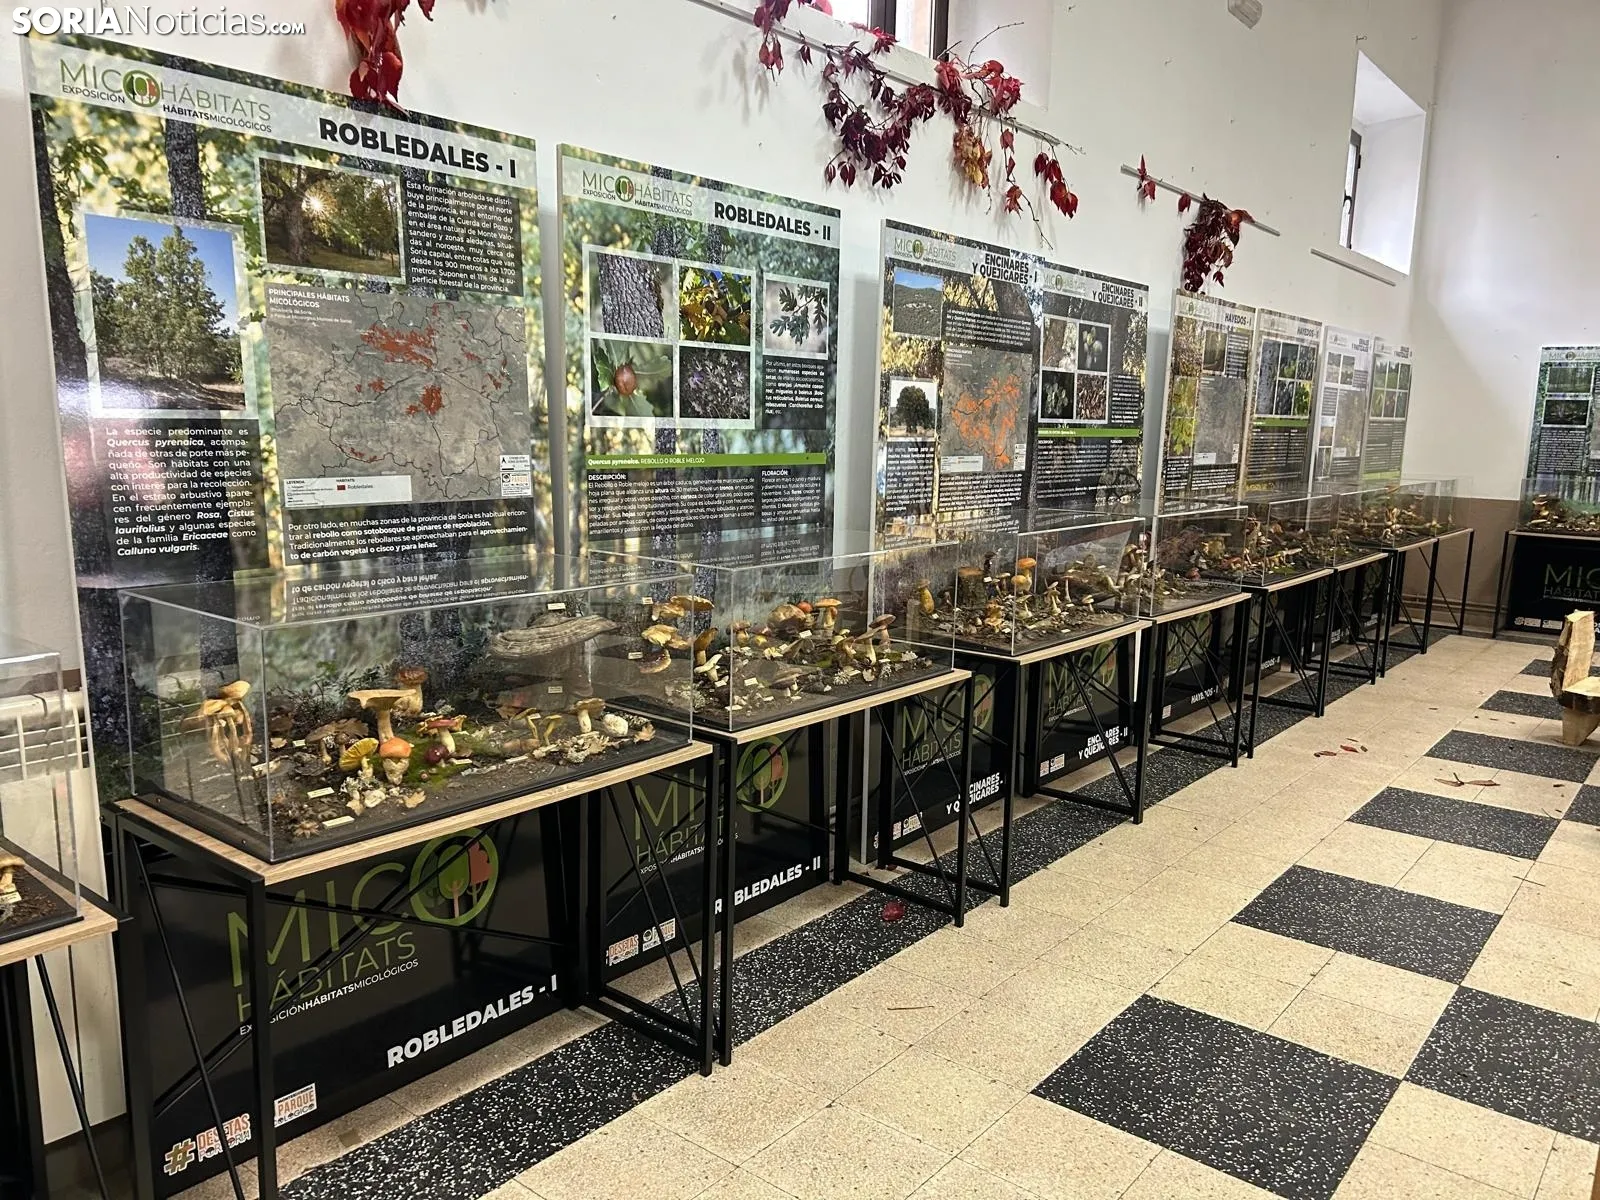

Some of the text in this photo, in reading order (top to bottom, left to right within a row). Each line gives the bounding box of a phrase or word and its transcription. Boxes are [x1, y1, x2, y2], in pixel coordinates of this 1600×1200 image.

[62, 84, 125, 105] EXPOSICIÓN
[319, 117, 490, 173] ROBLEDALES
[714, 201, 811, 236] ROBLEDALES
[985, 252, 1029, 273] ENCINARES
[972, 262, 978, 274] Y
[980, 264, 1028, 285] QUEJIGARES
[269, 288, 315, 299] PRINCIPALES
[1102, 282, 1134, 299] ENCINARES
[1092, 290, 1097, 300] Y
[1098, 291, 1134, 309] QUEJIGARES
[1225, 312, 1246, 326] HAYEDOS
[106, 427, 118, 435] La
[125, 427, 162, 437] especie
[168, 427, 233, 437] predominante
[588, 459, 611, 467] Quercus
[110, 469, 252, 481] alta productividad de especies
[168, 483, 188, 491] para
[113, 494, 125, 502] En
[143, 492, 176, 501] estrato
[180, 490, 222, 499] arbustivo
[225, 491, 253, 499] apare-
[136, 501, 212, 511] frecuentemente
[215, 500, 254, 510] ejempla-
[136, 514, 151, 522] del
[158, 513, 191, 523] género
[227, 509, 255, 518] Cistus
[115, 524, 166, 534] laurifolius
[179, 523, 215, 532] algunas
[218, 520, 256, 530] especies
[116, 537, 129, 545] de
[133, 536, 142, 544] la
[147, 534, 178, 543] familia
[182, 532, 228, 541] Ericaceae
[290, 538, 354, 550] Tradicionalmente
[356, 537, 366, 545] los
[368, 535, 401, 544] rebollares
[411, 531, 456, 543] aprovechaban
[458, 531, 471, 539] para
[473, 528, 478, 536] el
[480, 526, 527, 538] aprovechamien-
[117, 543, 200, 556] Calluna vulgaris.
[291, 551, 299, 559] to
[300, 551, 311, 559] de
[312, 548, 339, 558] carbón
[341, 545, 368, 557] vegetal
[377, 544, 394, 552] cisco
[396, 545, 400, 553] y
[402, 543, 417, 552] para
[418, 540, 438, 549] leñas.
[1078, 749, 1083, 760] Y
[946, 803, 953, 815] Y
[953, 782, 1000, 813] QJIGARES
[715, 863, 803, 915] RBLEDALES
[386, 985, 534, 1069] ROBLEDALES
[278, 1090, 315, 1116] PARQUE
